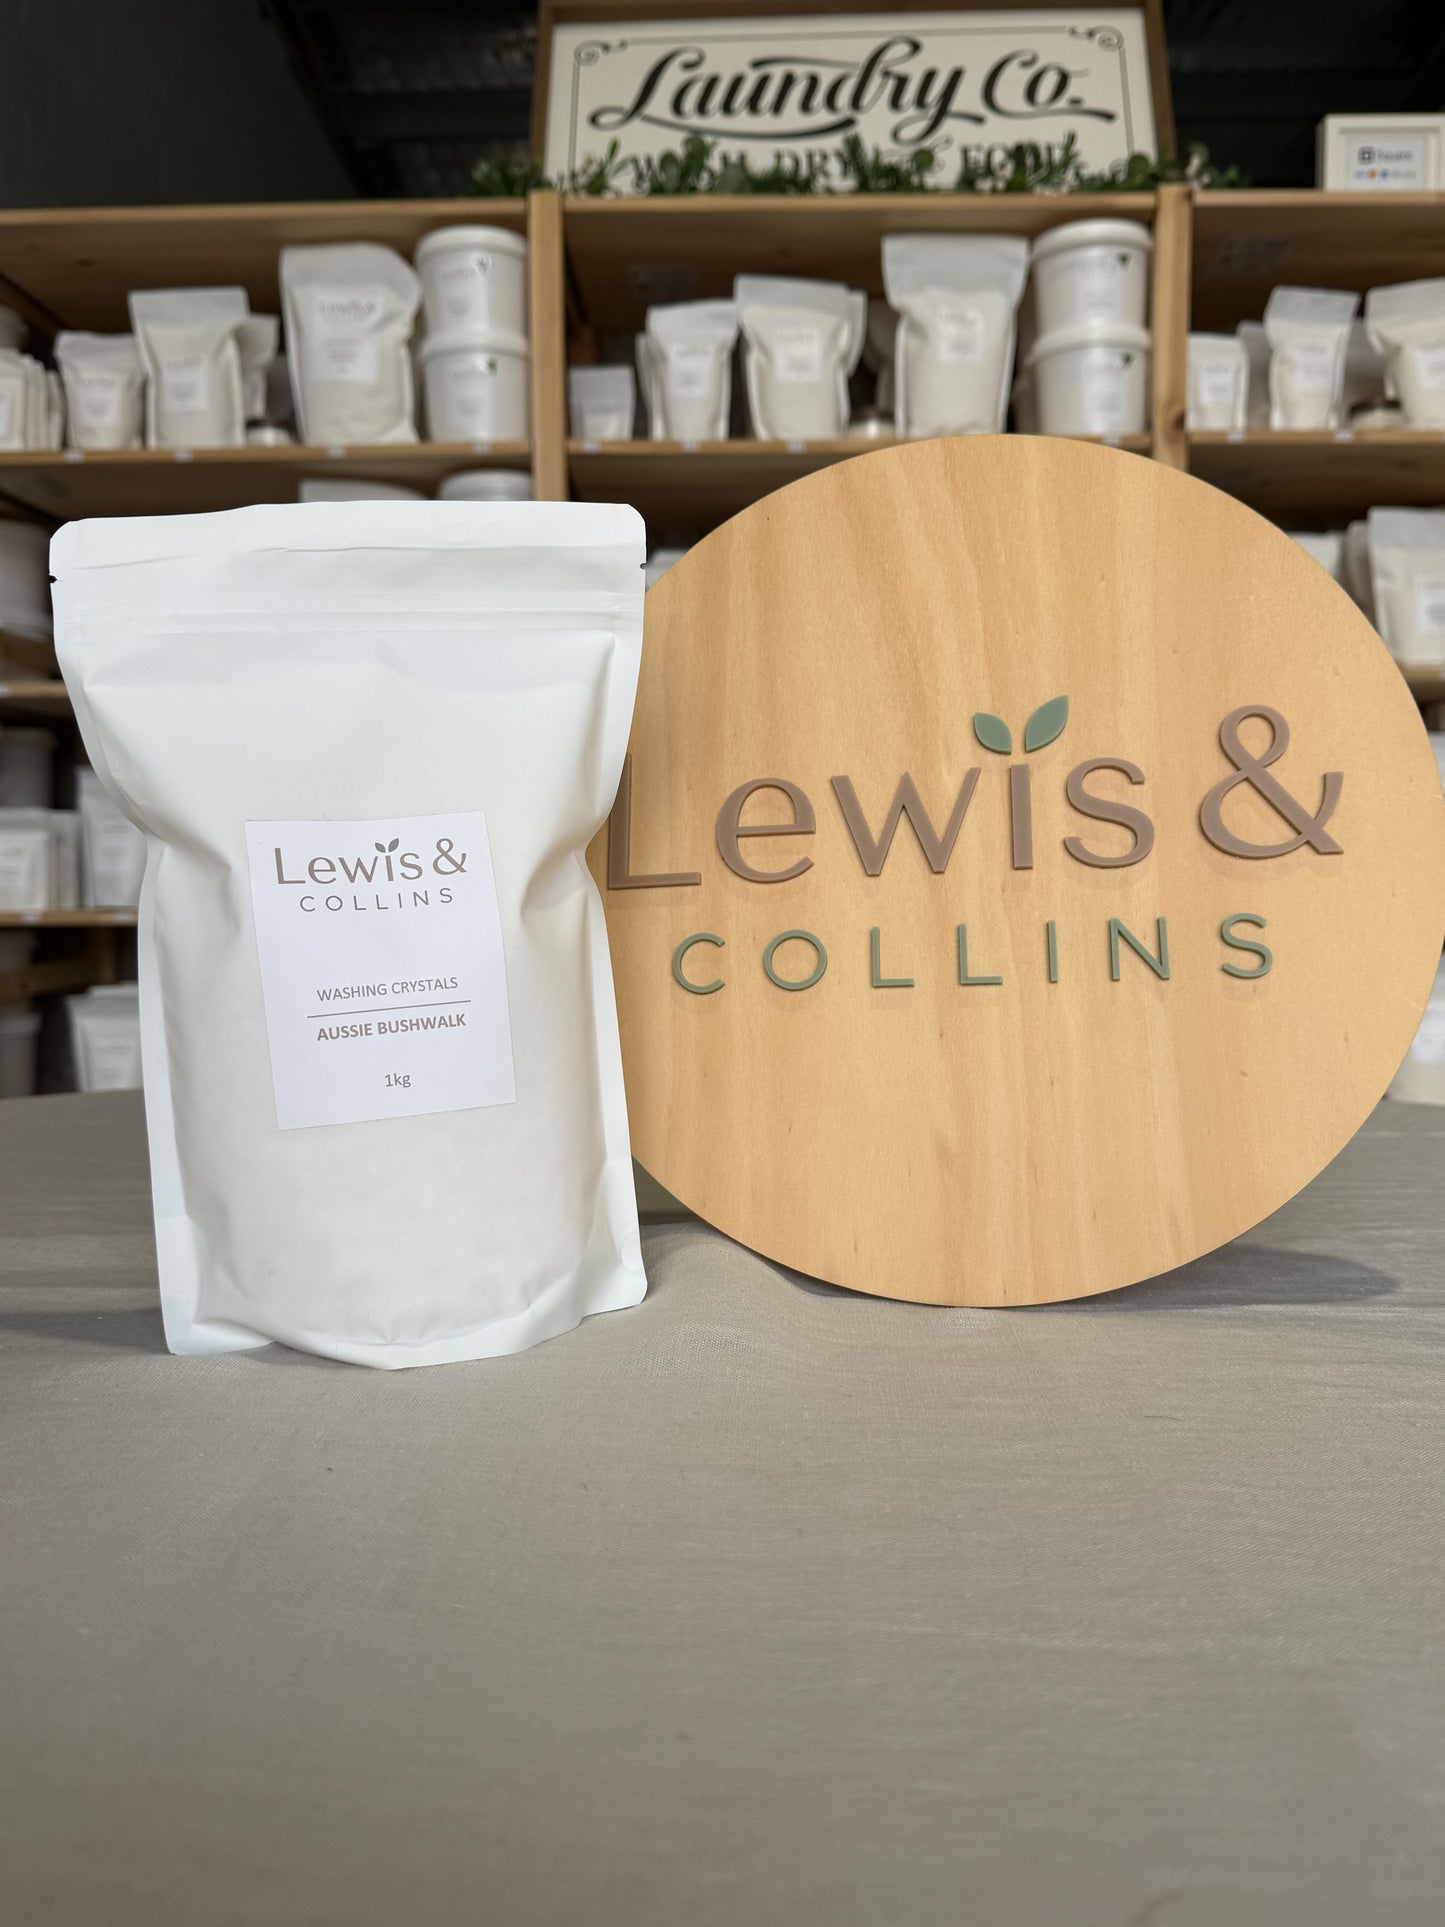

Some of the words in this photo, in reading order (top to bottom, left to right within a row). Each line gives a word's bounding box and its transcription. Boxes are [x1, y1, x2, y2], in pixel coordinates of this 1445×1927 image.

[588, 36, 985, 145] Laundry
[606, 695, 1155, 891] Lewis
[1199, 704, 1345, 860] &
[274, 838, 424, 885] Lewis
[432, 838, 468, 876] &
[299, 887, 454, 912] COLLINS
[672, 912, 1274, 995] COLLINS
[316, 983, 388, 1002] WASHING
[391, 976, 459, 995] CRYSTALS
[316, 1022, 373, 1042] AUSSIE
[376, 1013, 467, 1035] BUSHWALK
[384, 1073, 411, 1088] 1kg
